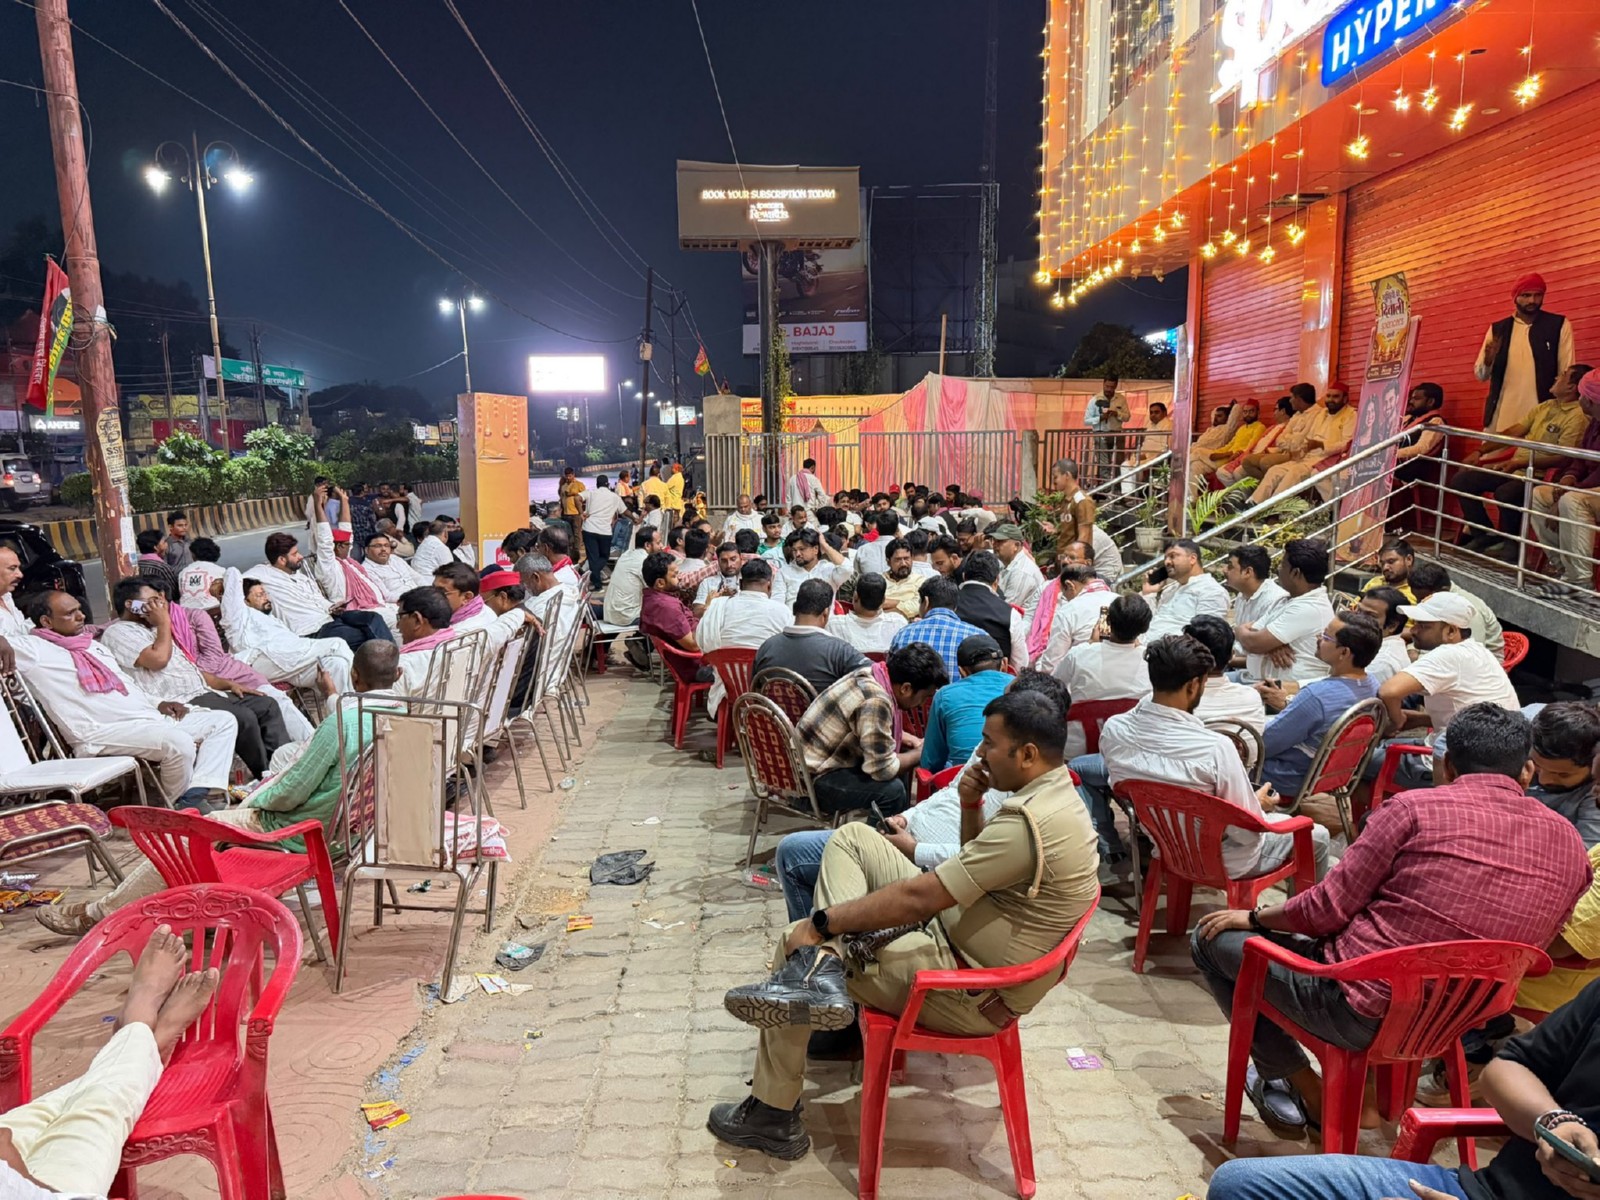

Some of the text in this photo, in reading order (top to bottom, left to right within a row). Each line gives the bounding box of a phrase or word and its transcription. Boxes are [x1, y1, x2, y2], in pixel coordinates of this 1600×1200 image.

[702, 188, 836, 199] BOOK YOUR SUBSCRIPTION TODAY!
[793, 325, 835, 337] BAJAJ
[47, 420, 80, 430] AMPERE
